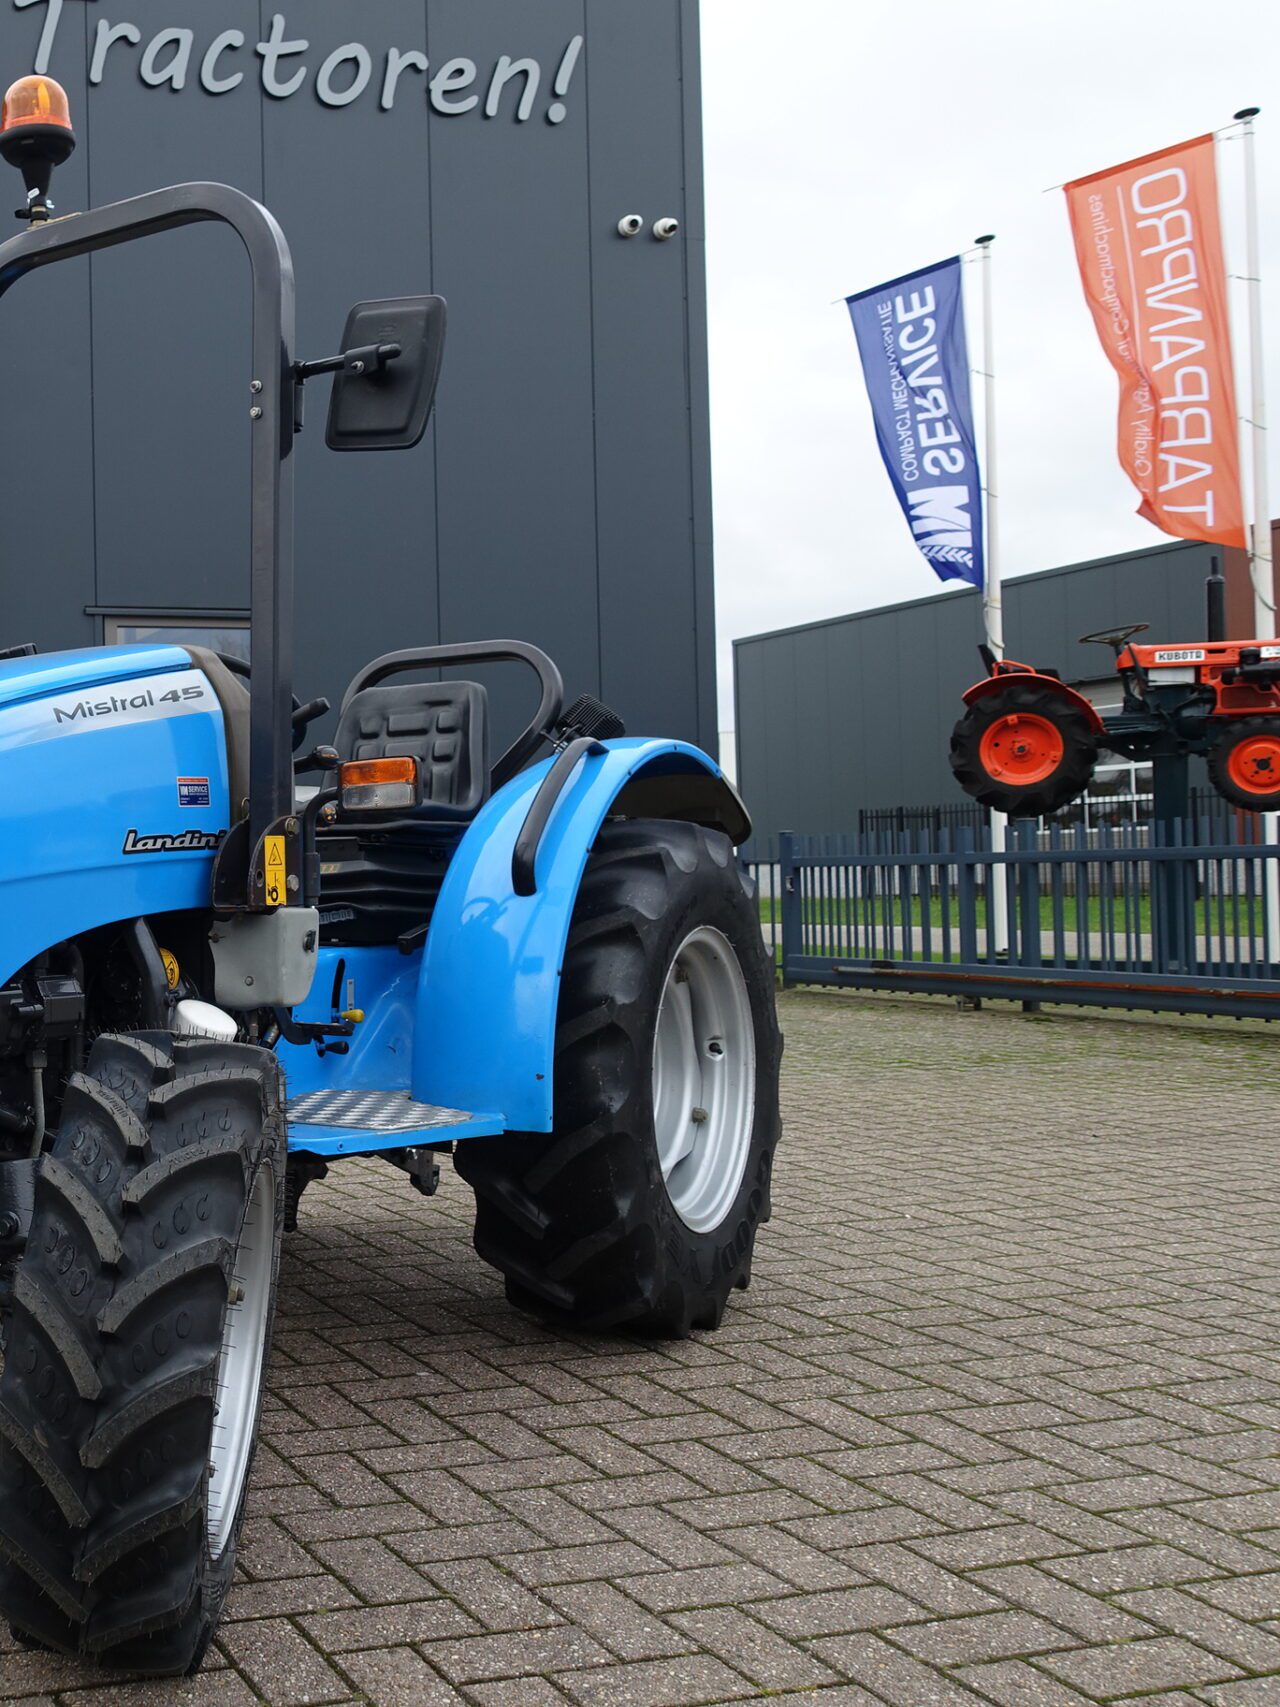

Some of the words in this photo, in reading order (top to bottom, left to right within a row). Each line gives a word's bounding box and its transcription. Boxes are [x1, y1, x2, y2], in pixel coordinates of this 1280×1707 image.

[14, 0, 583, 124] Tractoren!
[1158, 651, 1202, 661] KUBOTA
[53, 689, 154, 723] Mistral
[159, 685, 204, 702] 45
